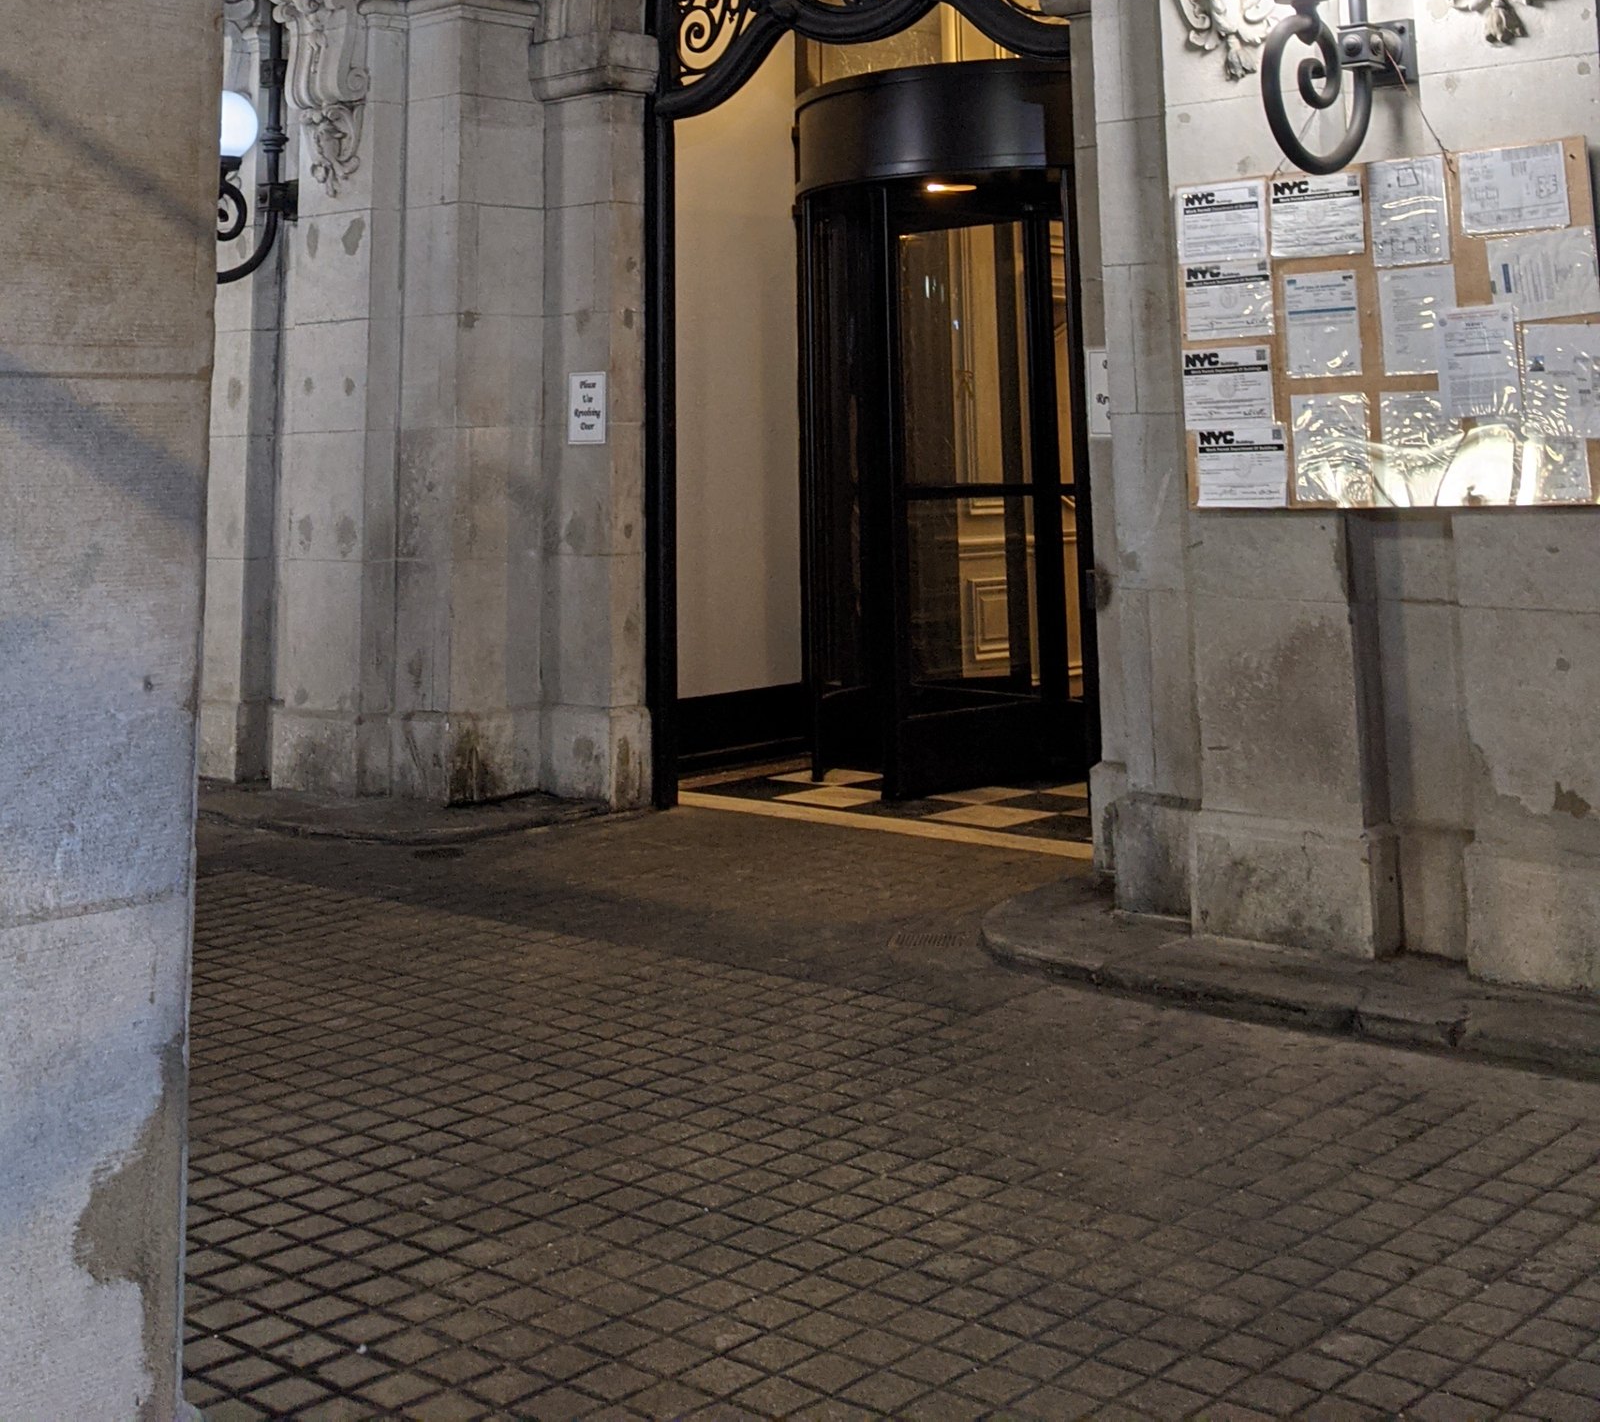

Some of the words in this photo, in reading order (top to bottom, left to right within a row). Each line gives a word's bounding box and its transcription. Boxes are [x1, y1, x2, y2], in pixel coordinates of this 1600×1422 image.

[1273, 181, 1309, 196] NYC
[1185, 192, 1214, 207] NYC
[1187, 265, 1221, 280] NYC
[1185, 353, 1220, 368] NYC
[574, 407, 601, 419] Revolving
[580, 422, 595, 431] Door
[1199, 431, 1235, 445] NYC
